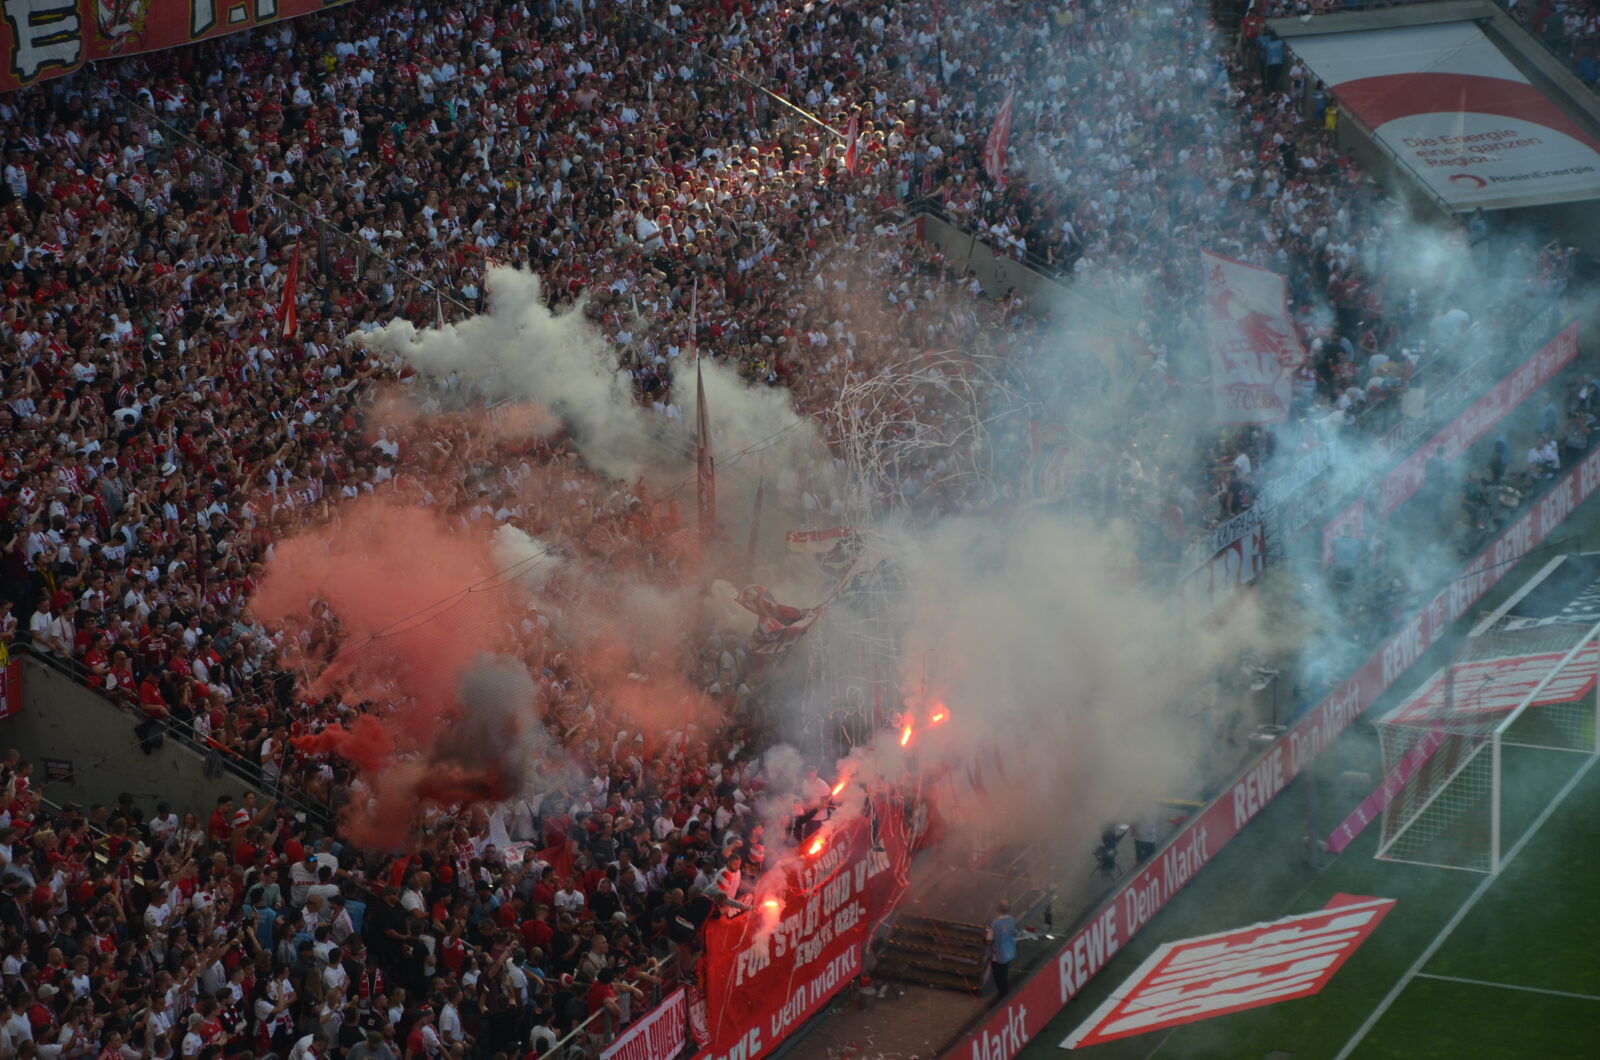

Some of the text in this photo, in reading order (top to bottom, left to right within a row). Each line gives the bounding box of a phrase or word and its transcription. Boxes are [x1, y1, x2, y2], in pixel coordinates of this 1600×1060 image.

[1403, 129, 1519, 148] Die Energie
[1468, 137, 1543, 154] ganzen
[1488, 165, 1596, 183] RheinEnergie
[1383, 613, 1423, 688] REWE
[1450, 553, 1486, 622] REWE
[1495, 512, 1532, 581] REWE
[1540, 474, 1574, 538] REWE
[1233, 748, 1284, 830] REWE
[1322, 682, 1360, 745] Markt
[823, 870, 850, 917] UND
[1058, 827, 1208, 1003] REWE Dein Markt
[811, 944, 857, 1004] Markt
[972, 1004, 1029, 1060] Markt
